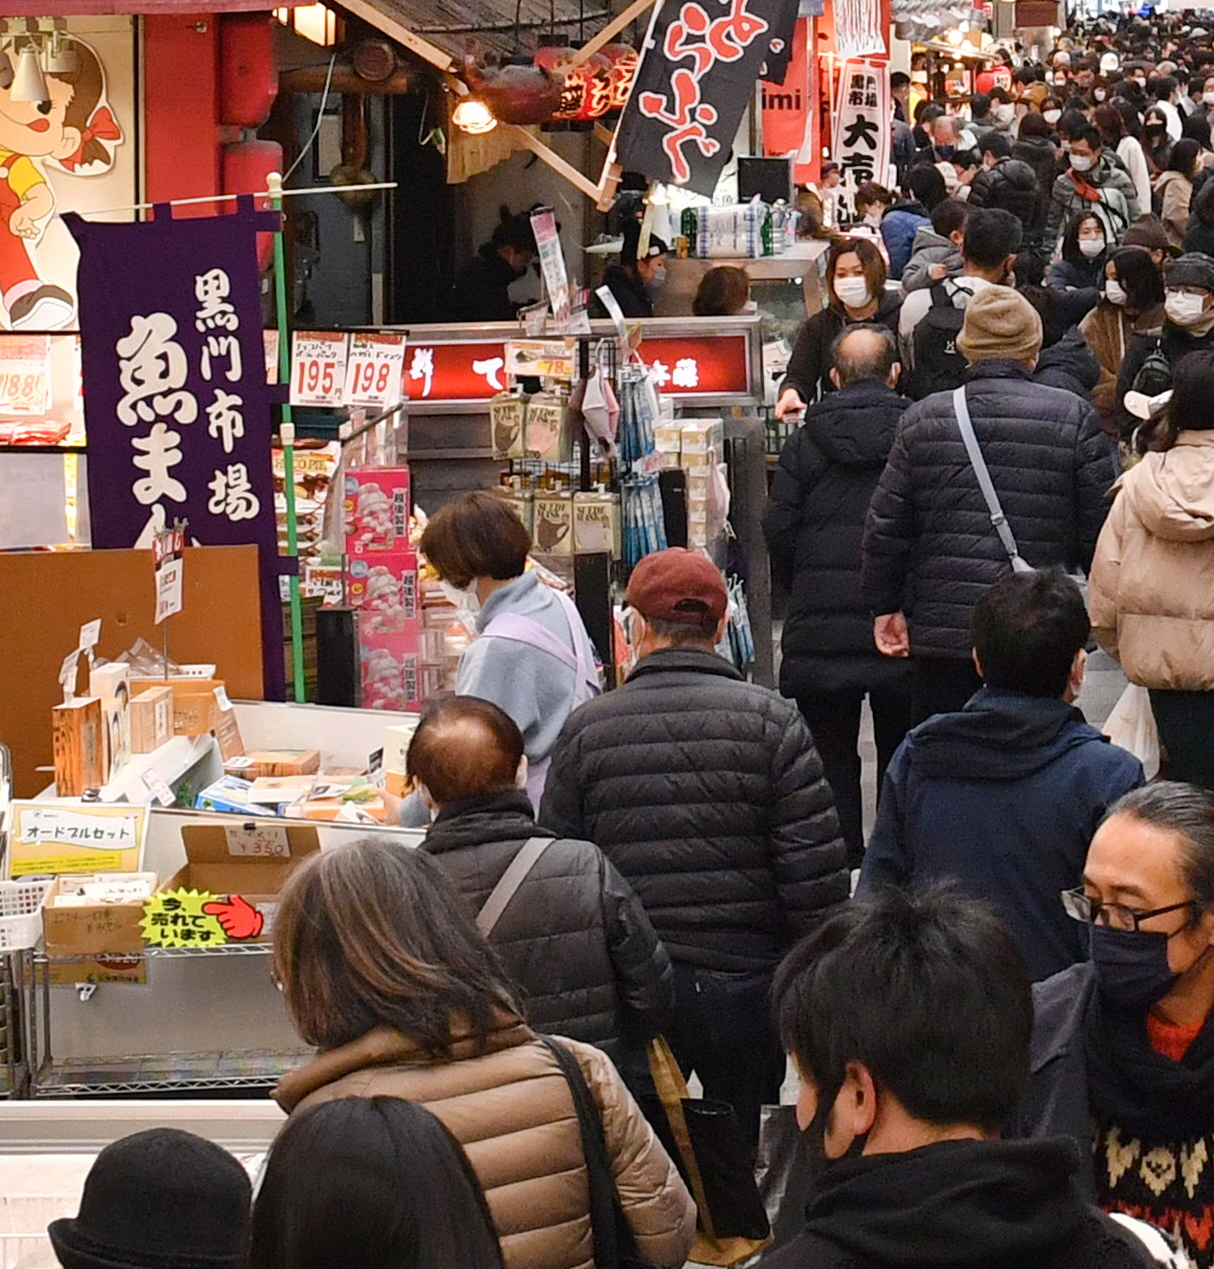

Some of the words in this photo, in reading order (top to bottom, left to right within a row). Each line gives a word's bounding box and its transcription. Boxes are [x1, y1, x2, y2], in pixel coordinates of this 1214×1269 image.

[297, 360, 336, 395] 195
[351, 362, 390, 395] 198
[195, 268, 260, 521] 黒門市場
[27, 826, 130, 840] オードブルセット
[151, 912, 207, 929] 売れて
[160, 929, 216, 941] います
